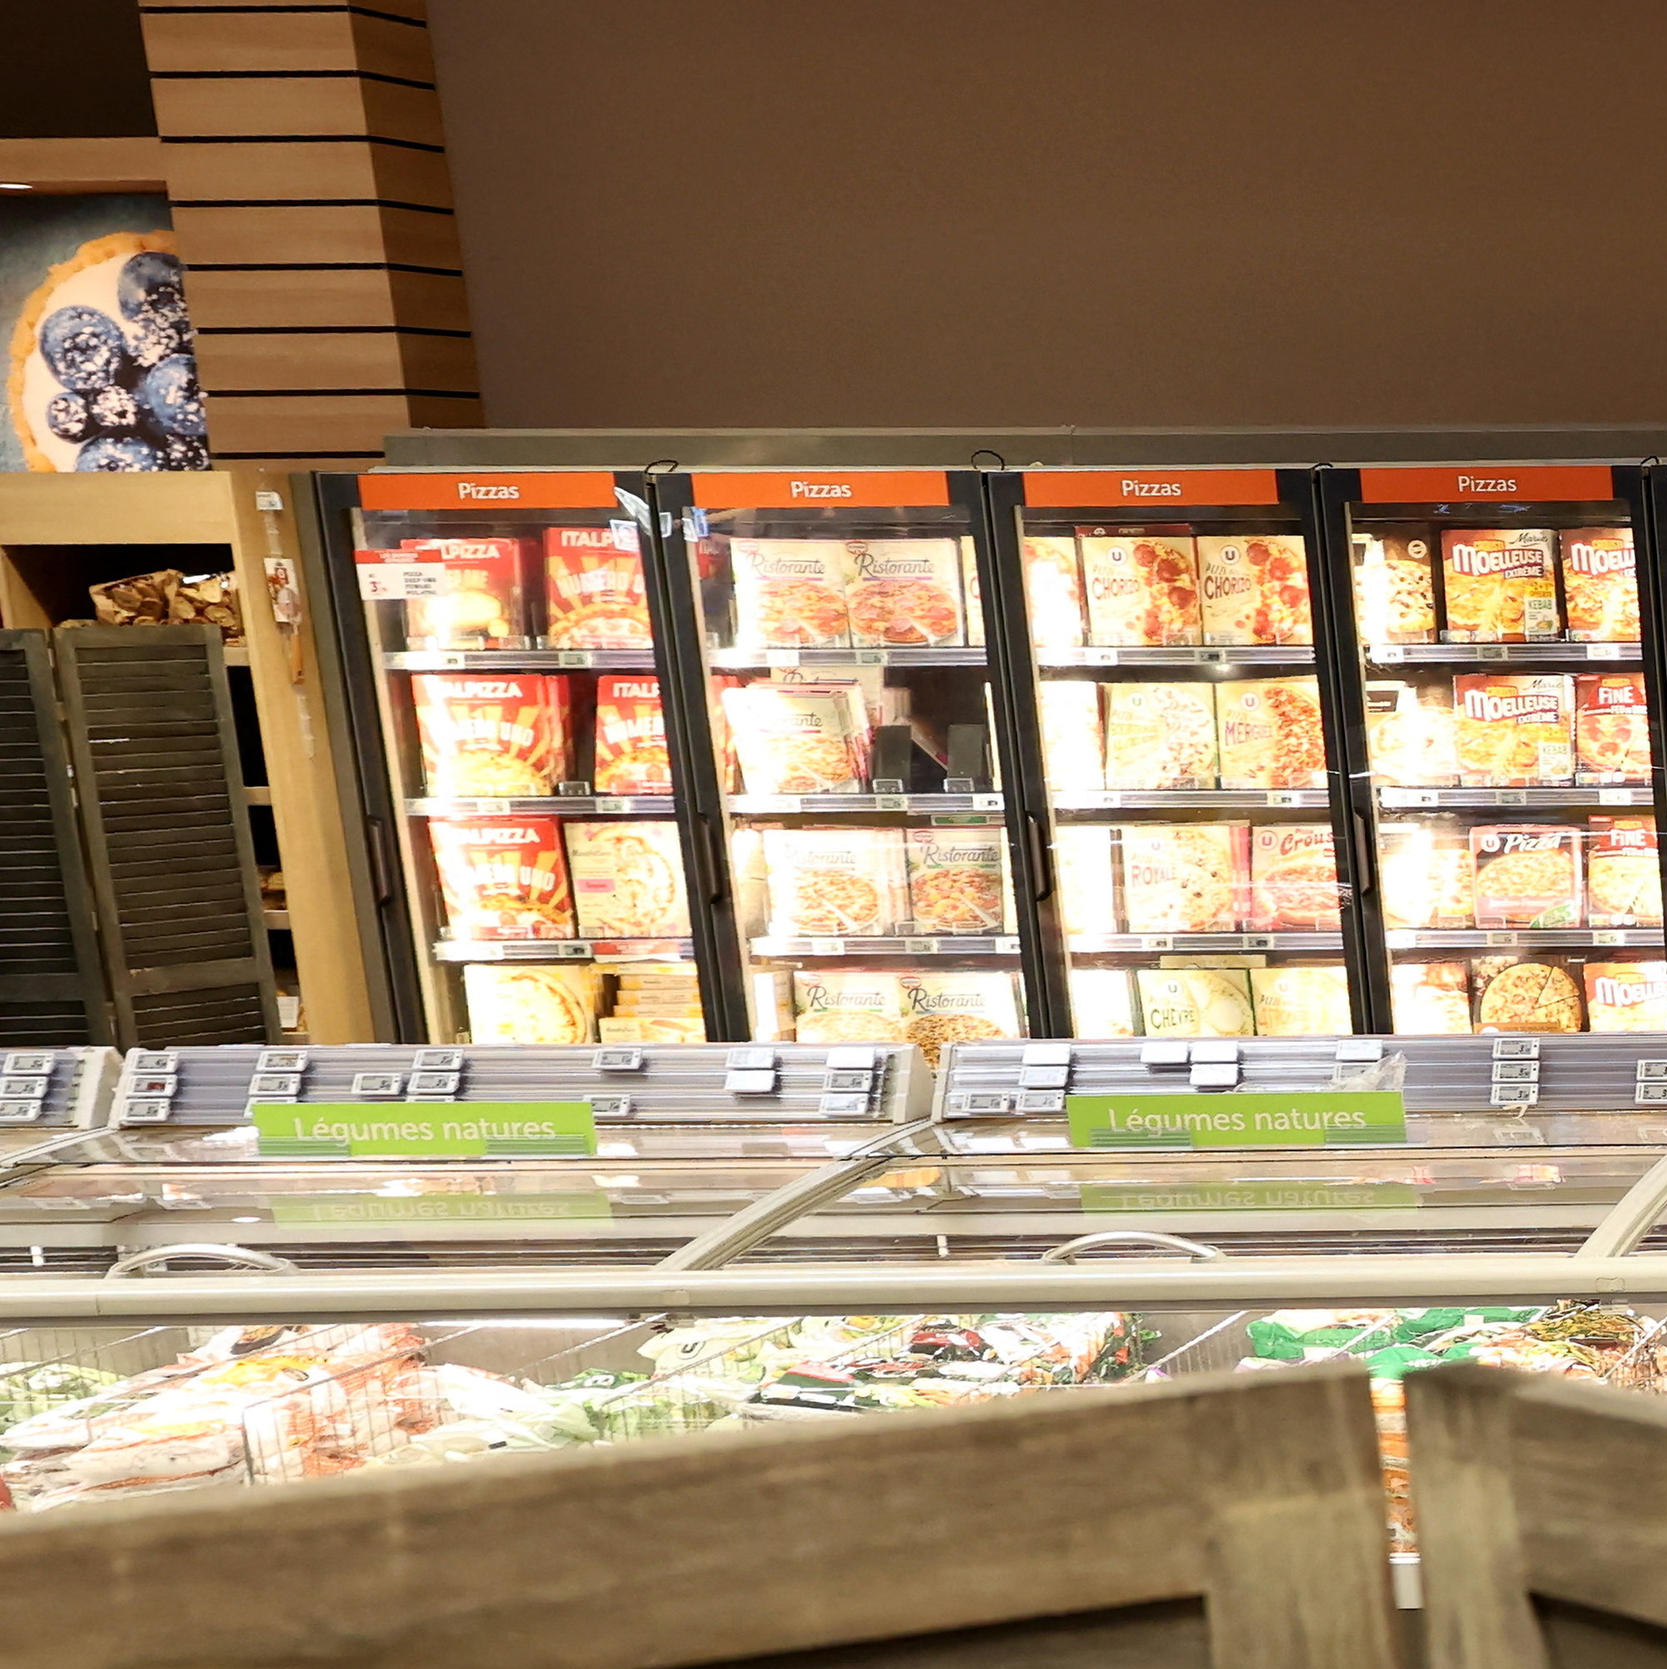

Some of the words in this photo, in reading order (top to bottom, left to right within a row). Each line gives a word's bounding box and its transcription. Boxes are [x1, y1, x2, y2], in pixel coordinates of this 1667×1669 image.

[458, 482, 520, 500] Pizzas
[790, 480, 852, 498] Pizzas
[1121, 479, 1182, 497] Pizzas
[1458, 475, 1517, 493] Pizzas
[750, 552, 825, 576] Ristorante
[855, 552, 936, 577] Ristorante
[1452, 543, 1544, 576] MOELLEUSE
[1204, 575, 1252, 599] CHORIZO
[1464, 689, 1559, 722] MOELLEUSE
[920, 843, 1001, 865] Ristorante
[1280, 830, 1334, 855] Crous
[294, 1116, 434, 1148] Légumes
[443, 1116, 556, 1141] natures
[1108, 1107, 1243, 1139] Légumes
[1254, 1105, 1366, 1131] natures
